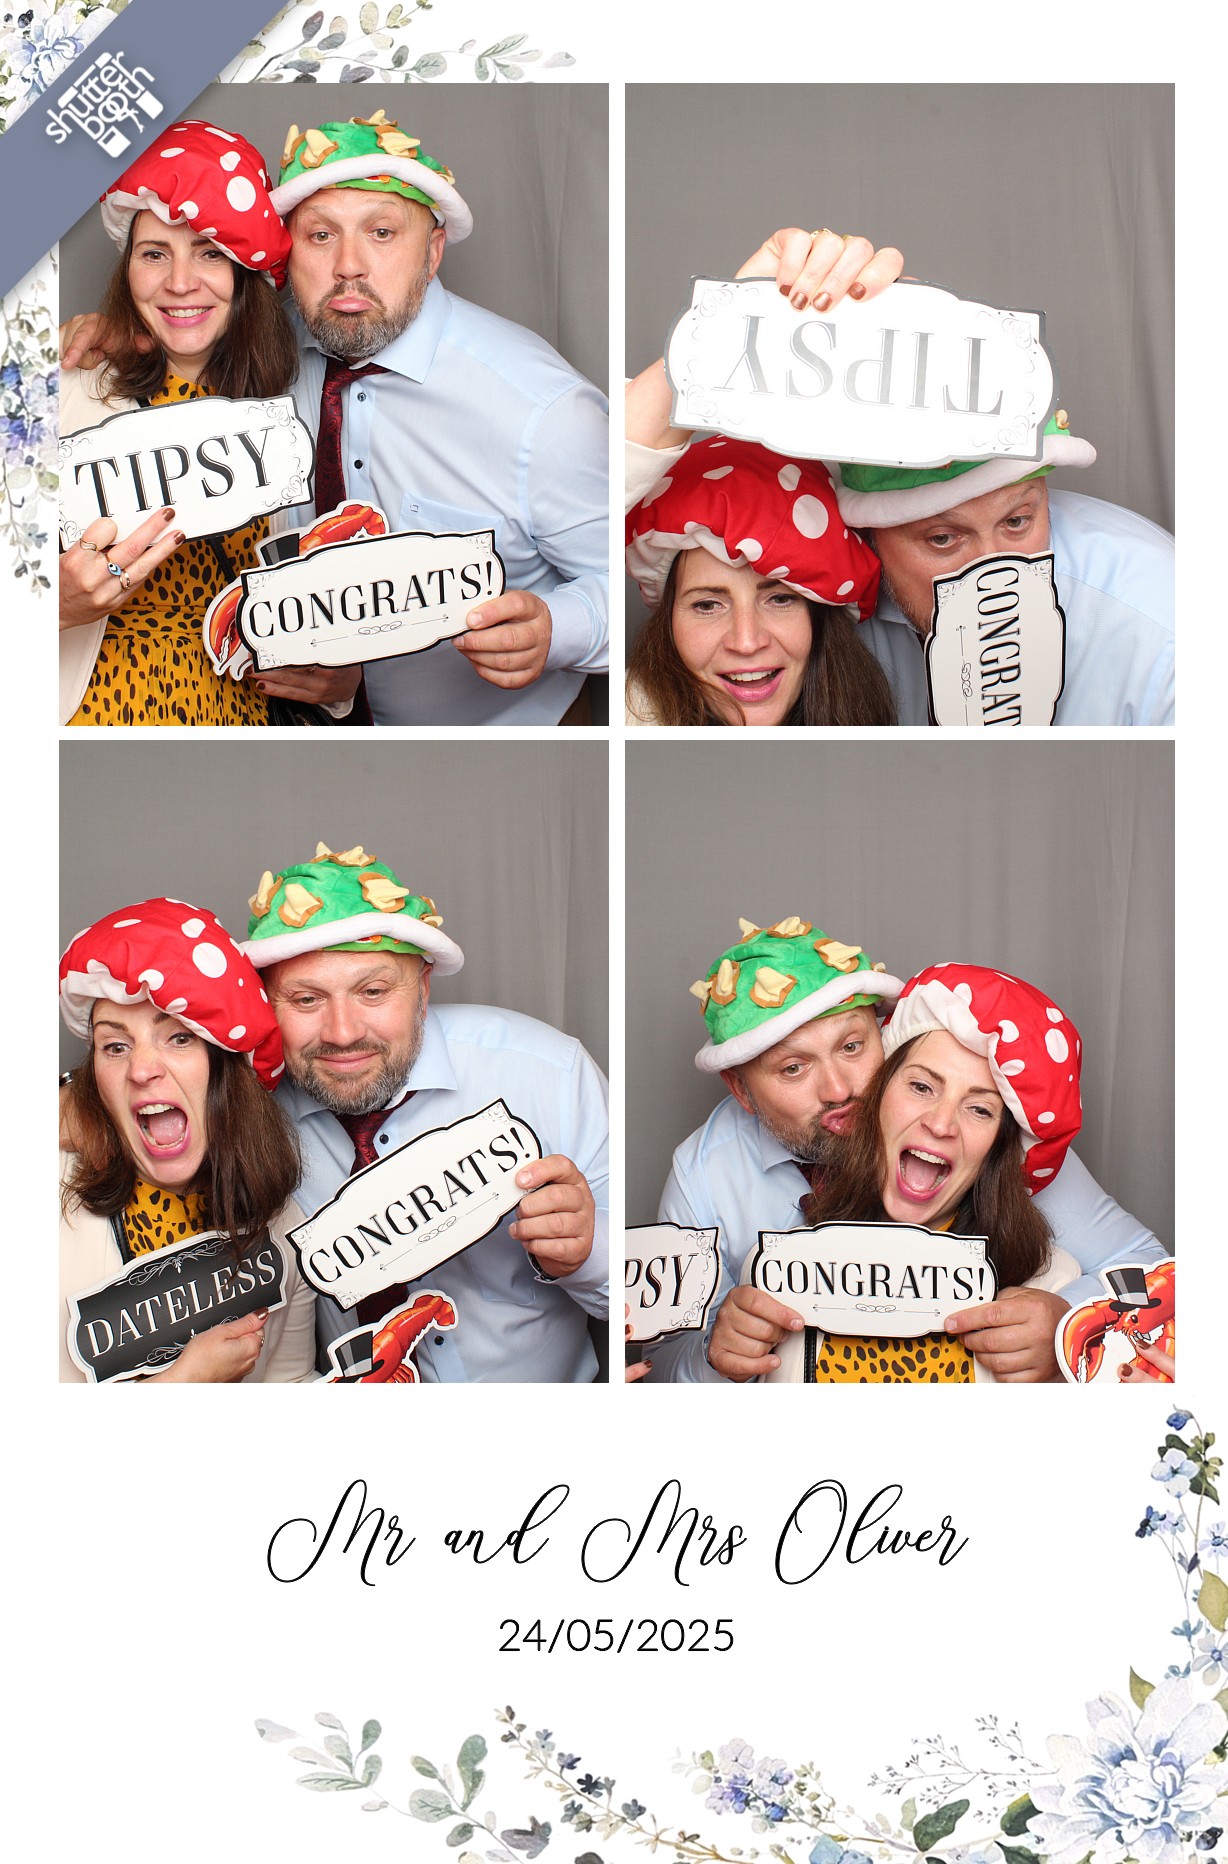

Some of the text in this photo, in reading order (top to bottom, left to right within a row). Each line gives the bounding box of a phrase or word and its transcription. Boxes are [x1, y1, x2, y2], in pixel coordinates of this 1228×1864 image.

[714, 315, 1003, 416] TIPSY
[74, 425, 275, 518] TIPSY
[248, 561, 495, 638] CONGRATS!
[308, 1127, 531, 1284] CONGRATS!
[84, 1250, 277, 1357] DATELESS
[762, 1260, 985, 1301] CONGRATS!
